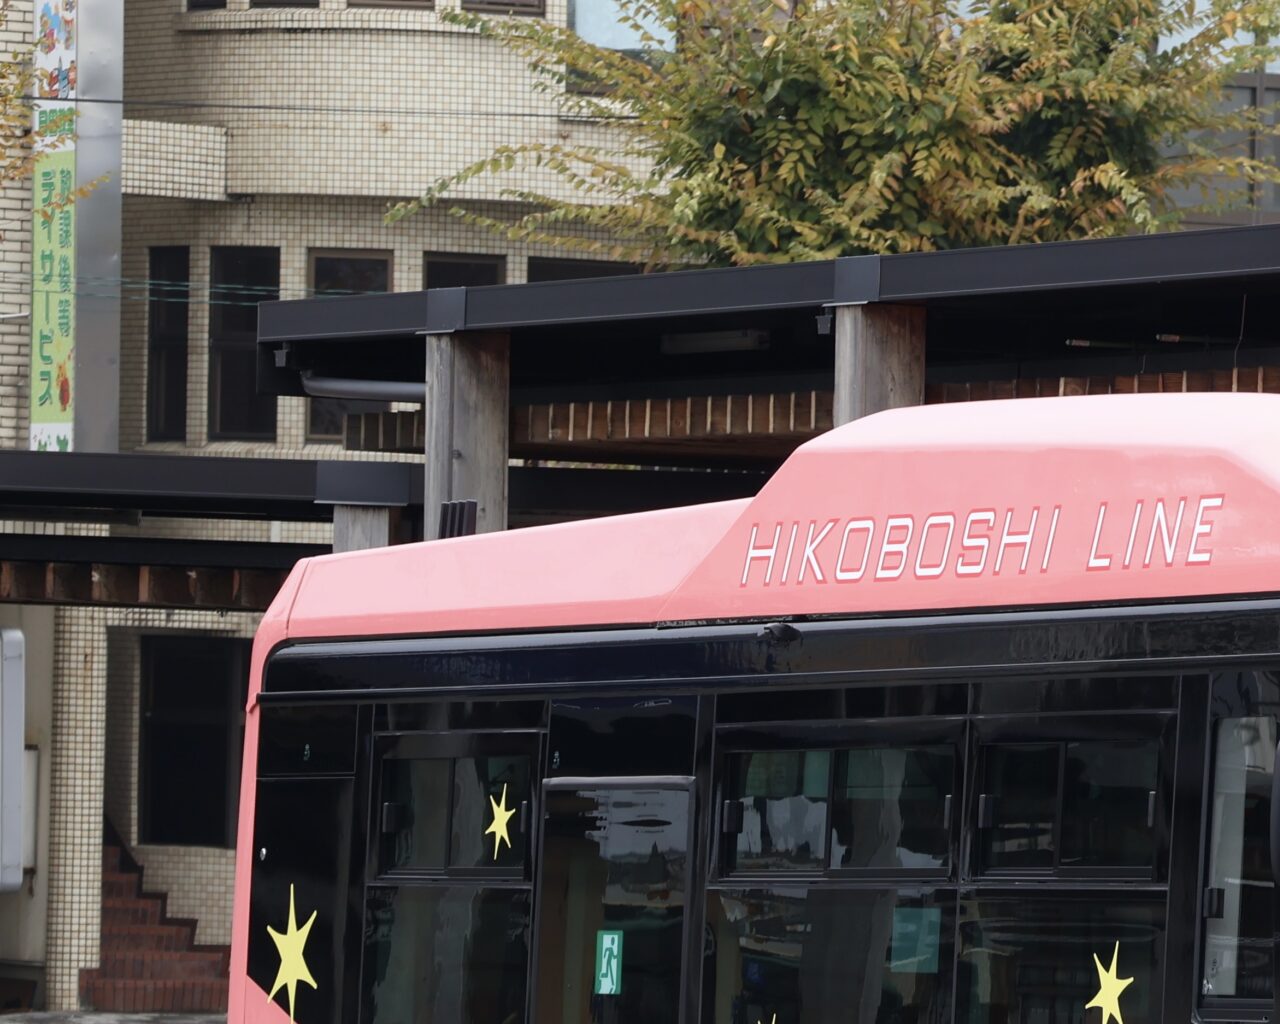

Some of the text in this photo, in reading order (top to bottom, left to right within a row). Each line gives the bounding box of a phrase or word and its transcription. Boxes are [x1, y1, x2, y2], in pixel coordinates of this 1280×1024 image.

[39, 170, 55, 406] デイサービス
[739, 493, 1225, 587] HIKOBOSHI LINE
